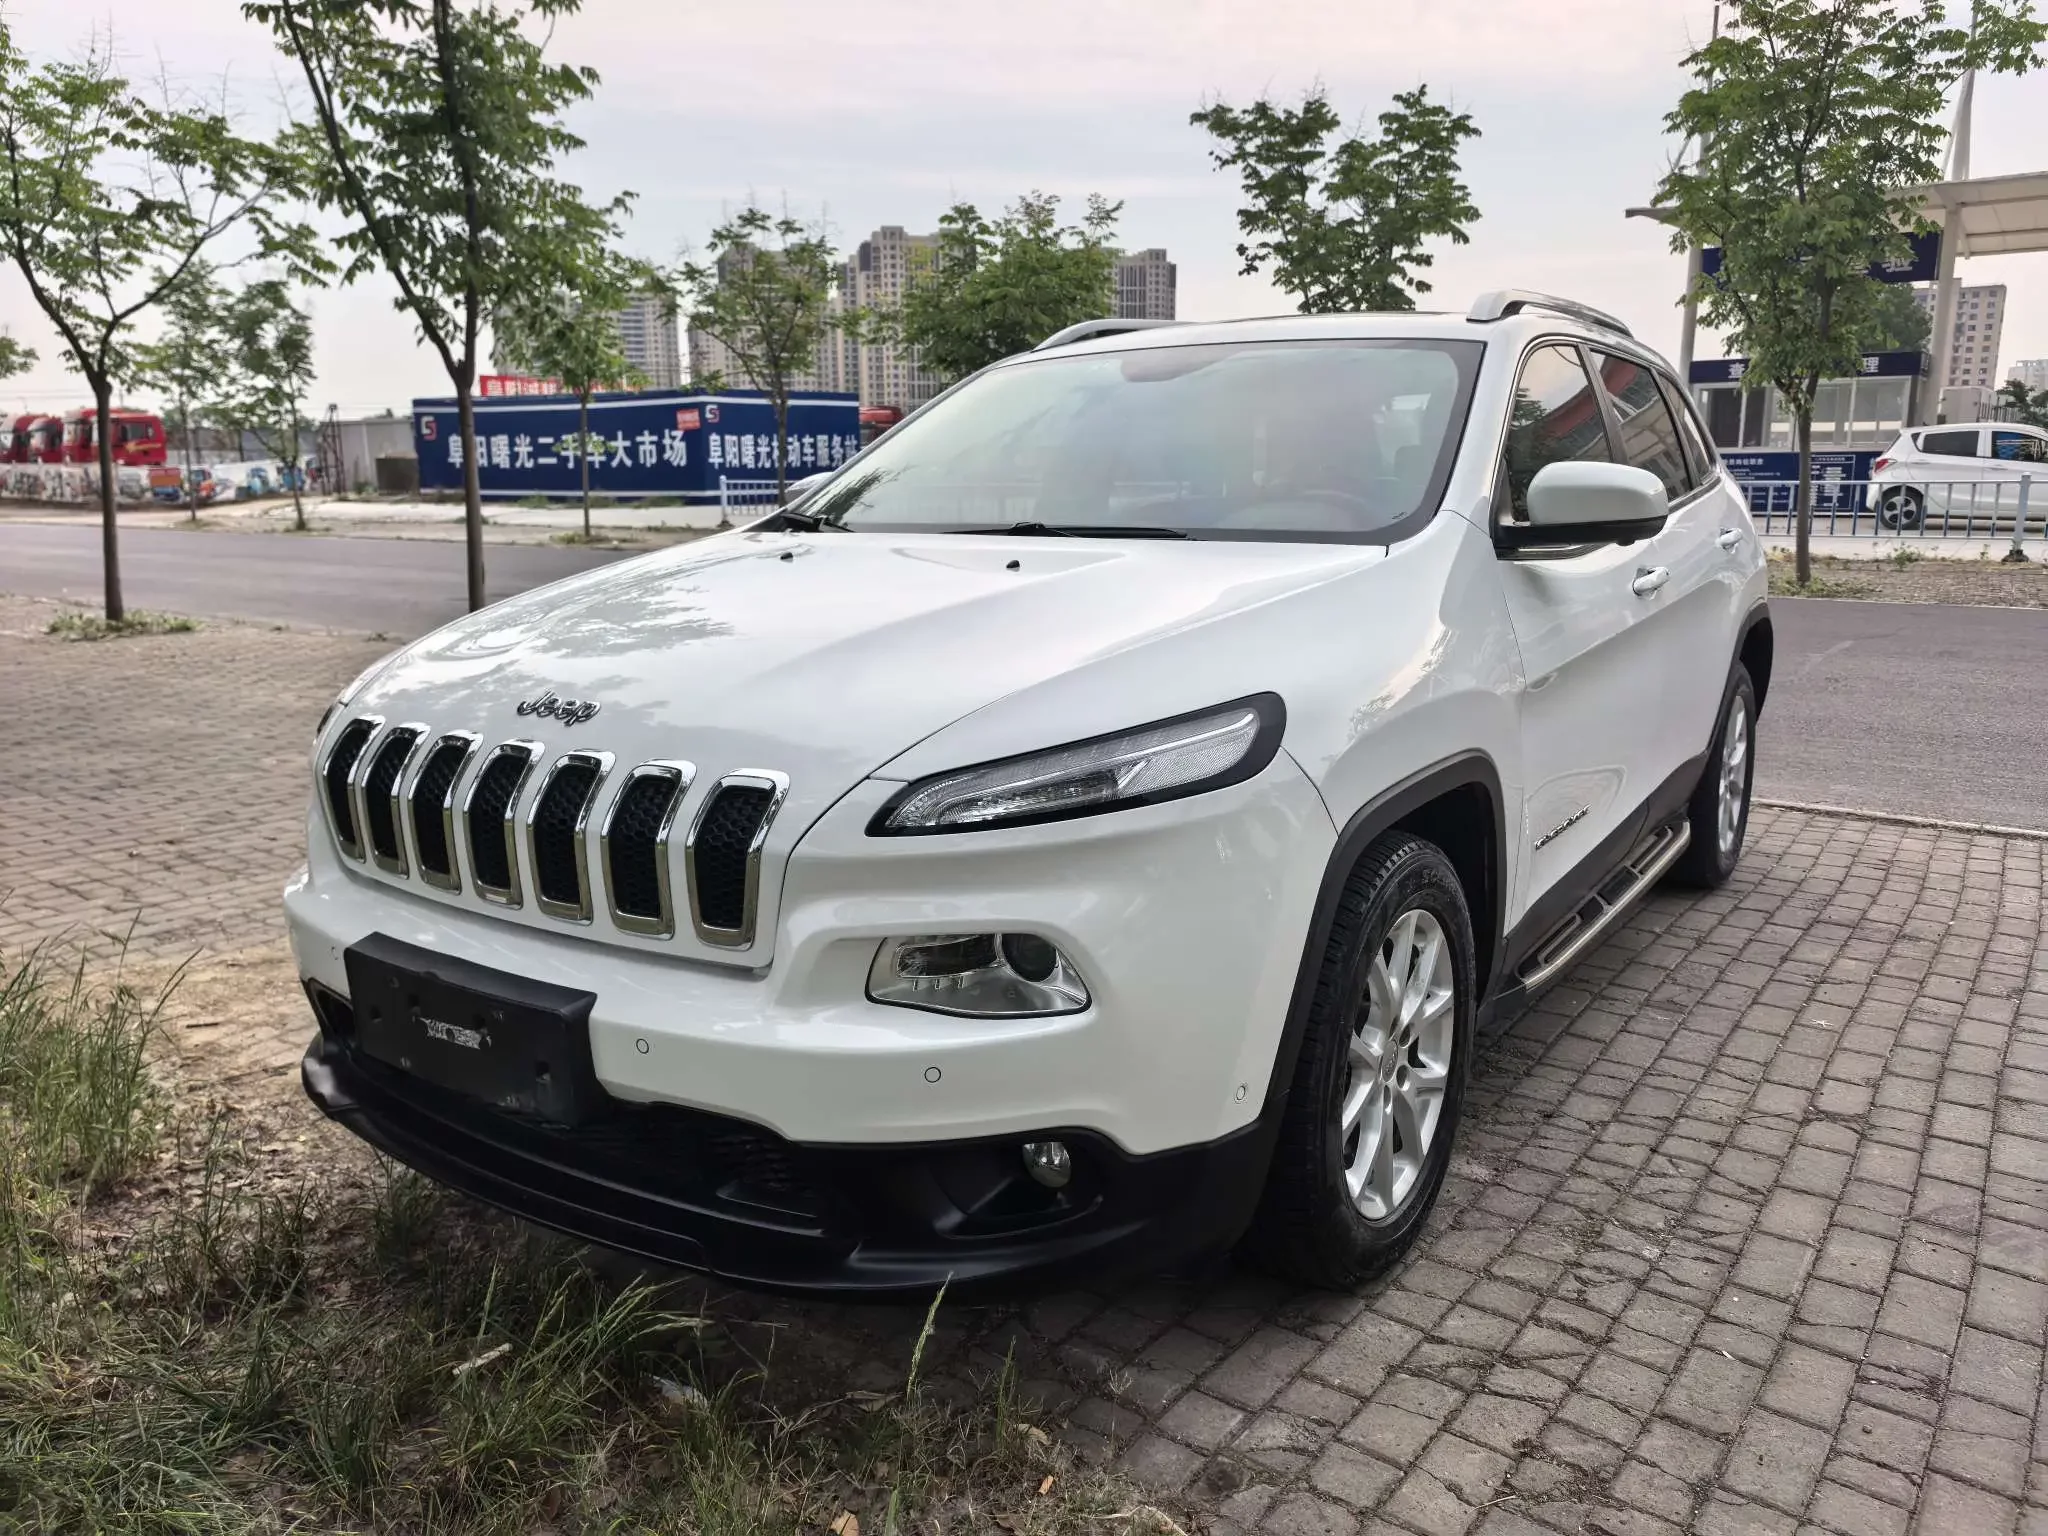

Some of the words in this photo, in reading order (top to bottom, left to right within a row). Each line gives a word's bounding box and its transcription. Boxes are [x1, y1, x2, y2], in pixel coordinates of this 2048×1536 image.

[448, 428, 688, 469] 阜阳曙光二手车大市场
[516, 689, 602, 727] Jeep
